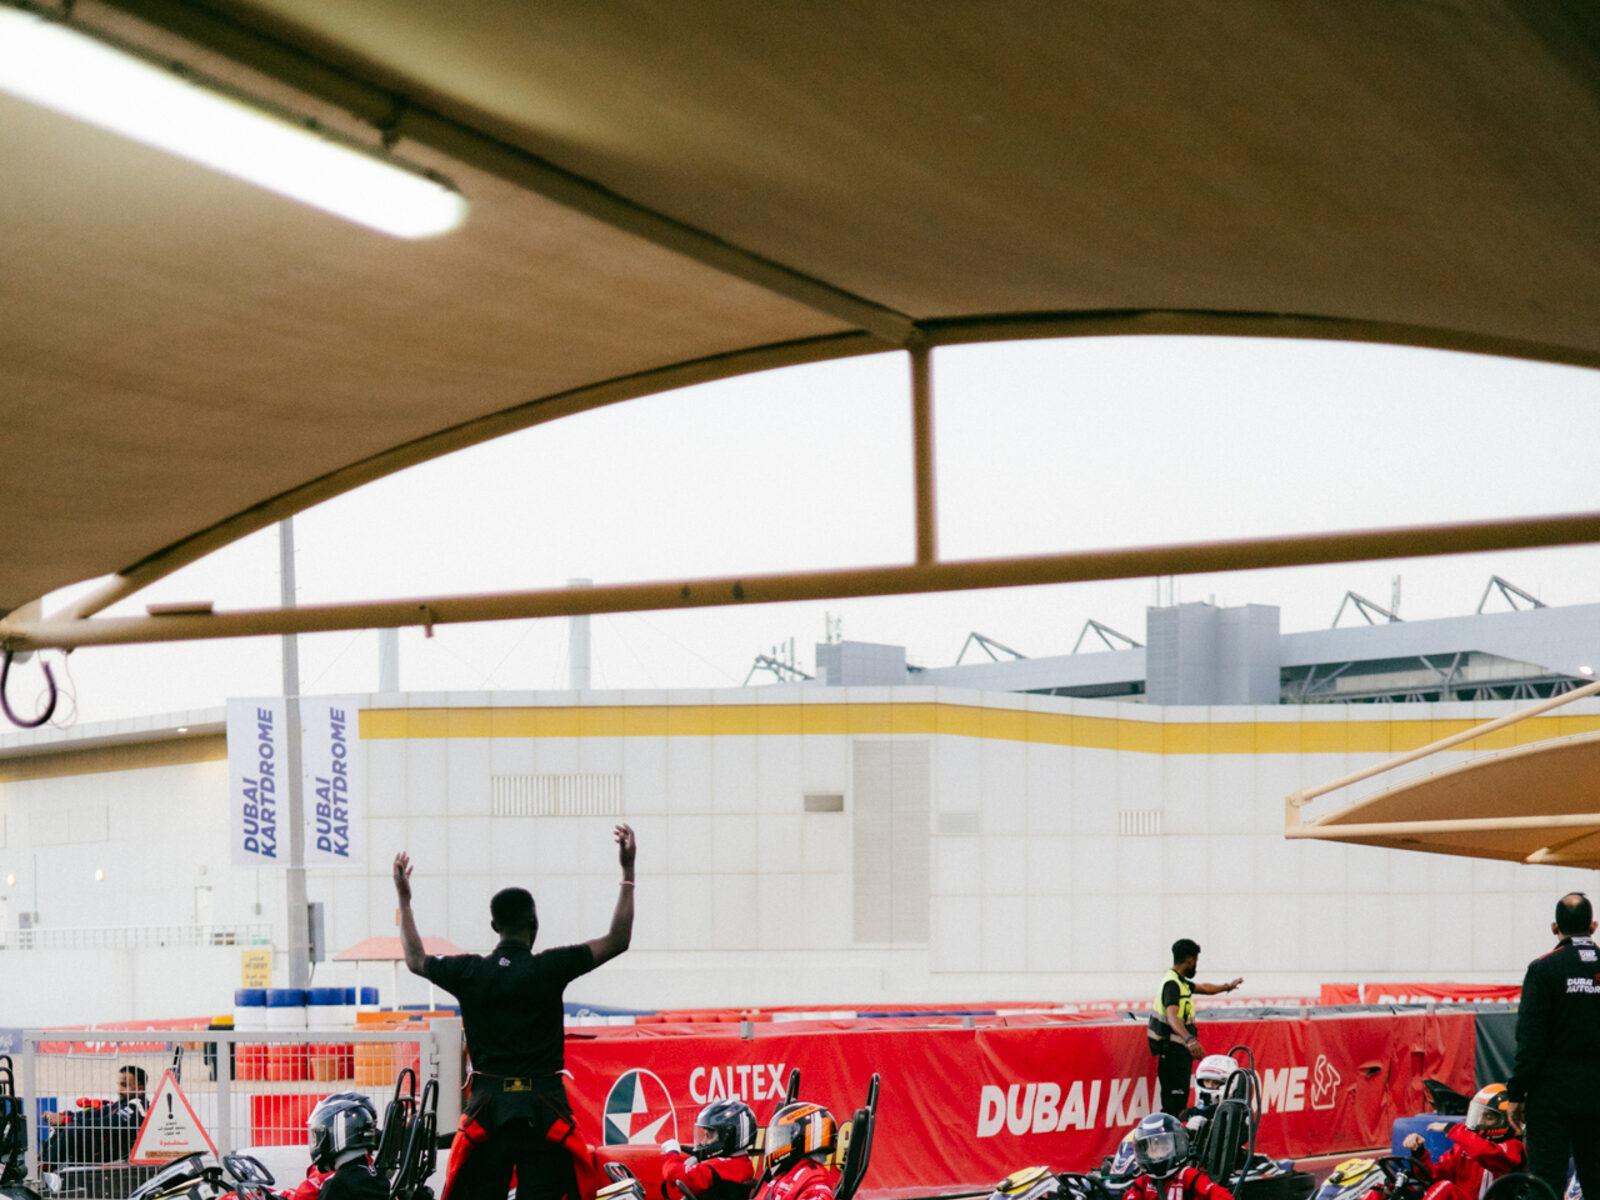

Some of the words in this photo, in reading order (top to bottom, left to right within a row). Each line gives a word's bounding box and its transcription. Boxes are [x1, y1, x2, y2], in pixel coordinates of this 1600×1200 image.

[243, 776, 259, 853] DUBAI
[257, 707, 277, 858] KARTDROME
[315, 776, 332, 852] DUBAI
[330, 706, 349, 857] KARTDROME
[1567, 978, 1593, 986] DUBAI
[689, 1063, 787, 1105] CALTEX
[977, 1080, 1101, 1137] DUBAI
